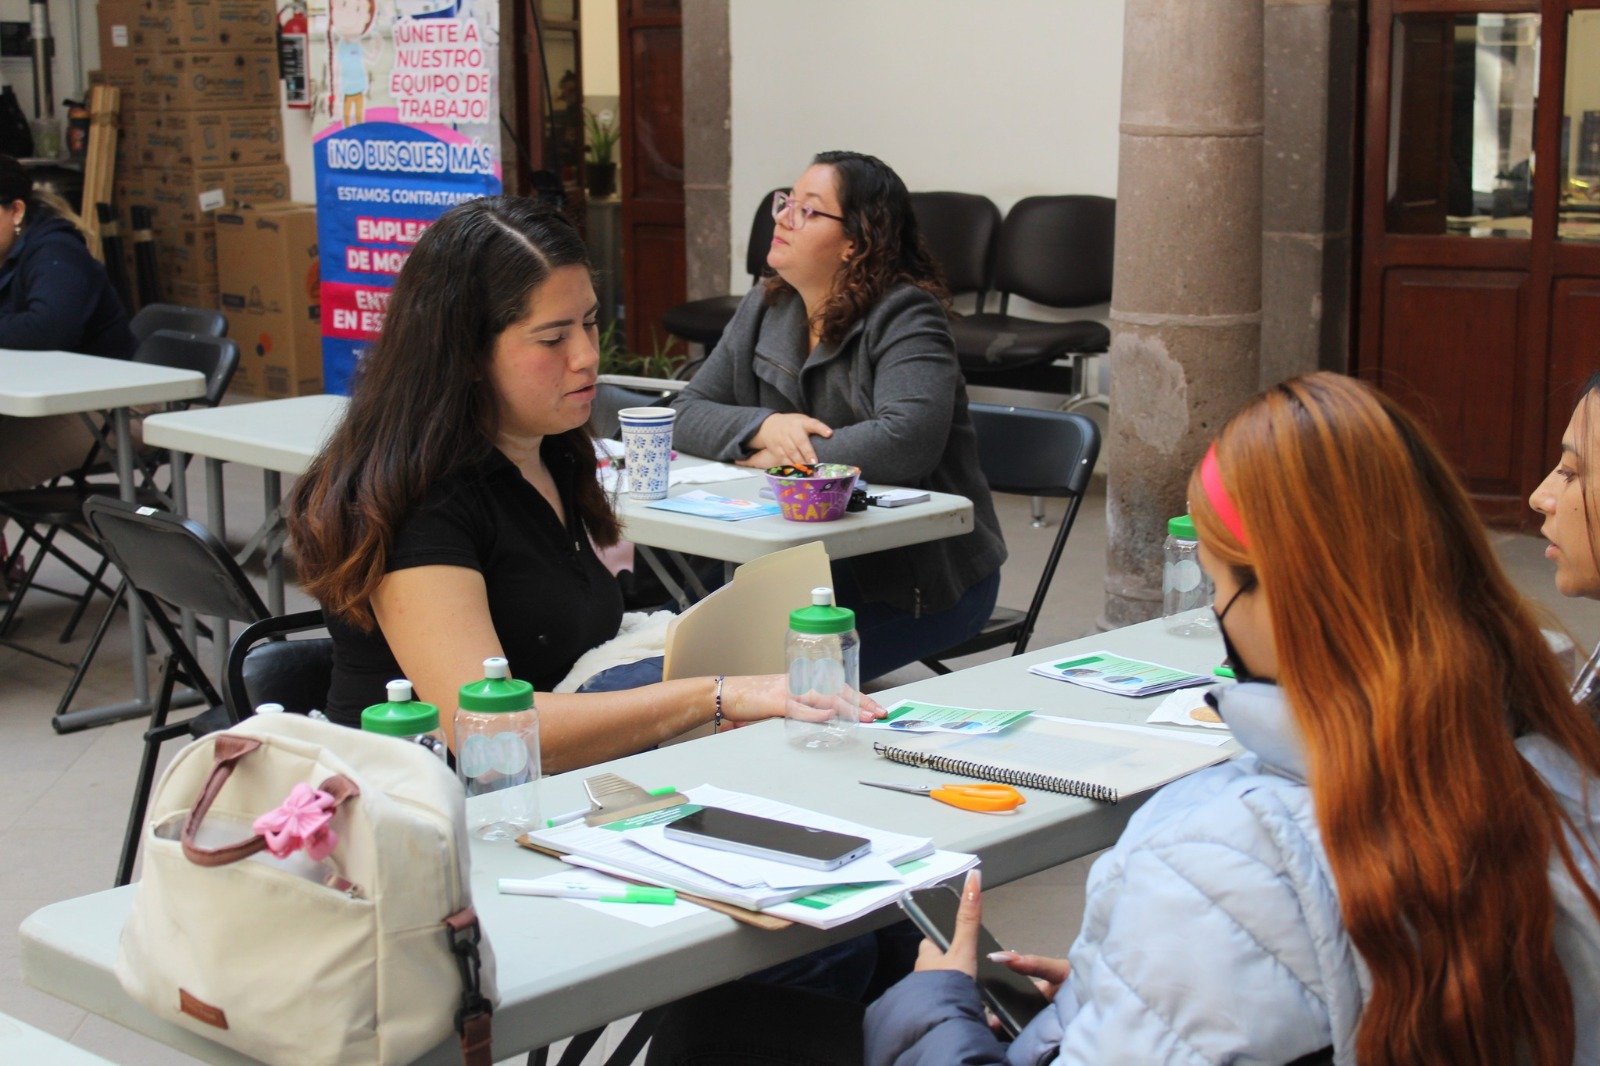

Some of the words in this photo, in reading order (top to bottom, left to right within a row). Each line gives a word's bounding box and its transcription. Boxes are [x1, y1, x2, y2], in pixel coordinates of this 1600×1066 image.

[464, 24, 477, 42] A
[397, 49, 481, 67] NUESTRO
[392, 74, 460, 95] EQUIPO
[466, 74, 488, 92] DE
[400, 99, 487, 118] TRABAJO!
[367, 142, 444, 171] BUSQUES
[337, 187, 390, 203] ESTAMOS
[357, 219, 427, 243] EMPLEA
[348, 249, 370, 271] DE
[373, 252, 408, 273] MO
[355, 290, 391, 311] ENT
[333, 308, 357, 330] EN
[361, 311, 387, 333] ES
[782, 501, 832, 520] REAT
